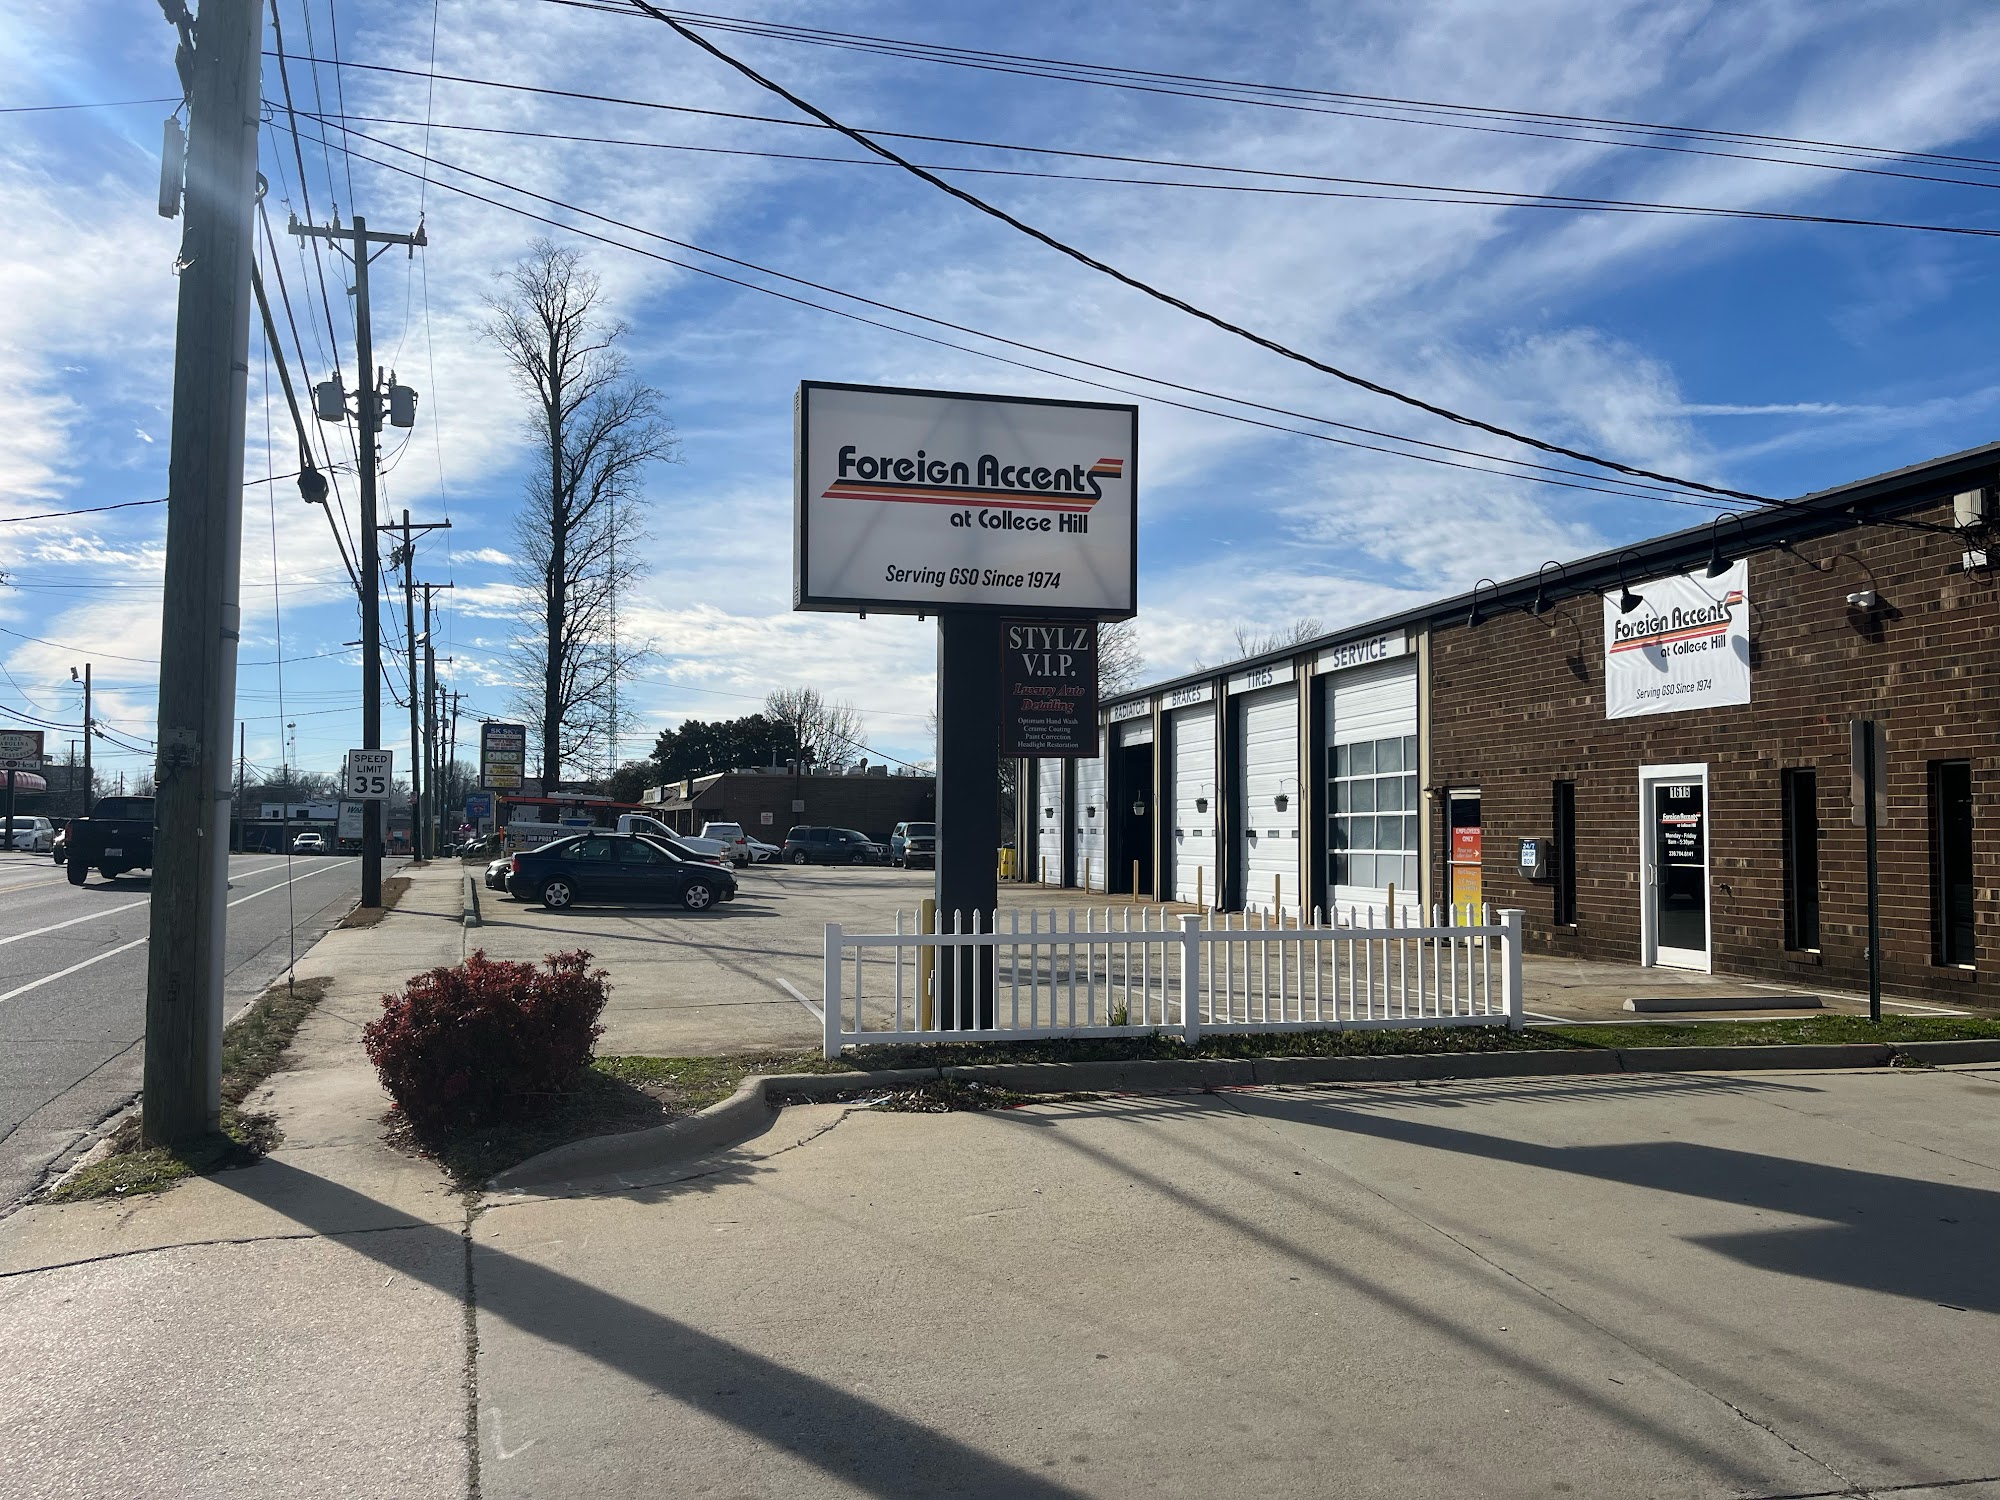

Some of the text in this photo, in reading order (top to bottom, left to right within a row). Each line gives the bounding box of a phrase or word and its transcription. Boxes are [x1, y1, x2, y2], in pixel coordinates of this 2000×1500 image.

[838, 445, 1122, 499] Foreign Accents
[950, 509, 1088, 534] at College Hill
[885, 564, 1061, 589] Serving GSO Since 1974
[1614, 600, 1743, 640] Foreign Accents
[1009, 626, 1089, 650] STYLZ
[1660, 634, 1726, 658] at College Hill
[1333, 637, 1387, 668] SERVICE
[1022, 653, 1076, 677] V.I.P.
[1246, 666, 1273, 689] TIRES
[1013, 683, 1085, 697] Luxury Auto
[1171, 685, 1201, 706] BRAKES
[1636, 679, 1712, 700] Serving GSO Since 1974
[1020, 699, 1074, 714] Detailing
[1114, 700, 1145, 720] RADIATOR
[1018, 718, 1045, 726] Optimum
[1048, 725, 1071, 733] Coating
[1018, 740, 1045, 749] Headlight
[353, 754, 388, 764] SPEED
[356, 765, 383, 774] LIMIT
[353, 776, 386, 794] 35
[1670, 787, 1690, 798] 1616
